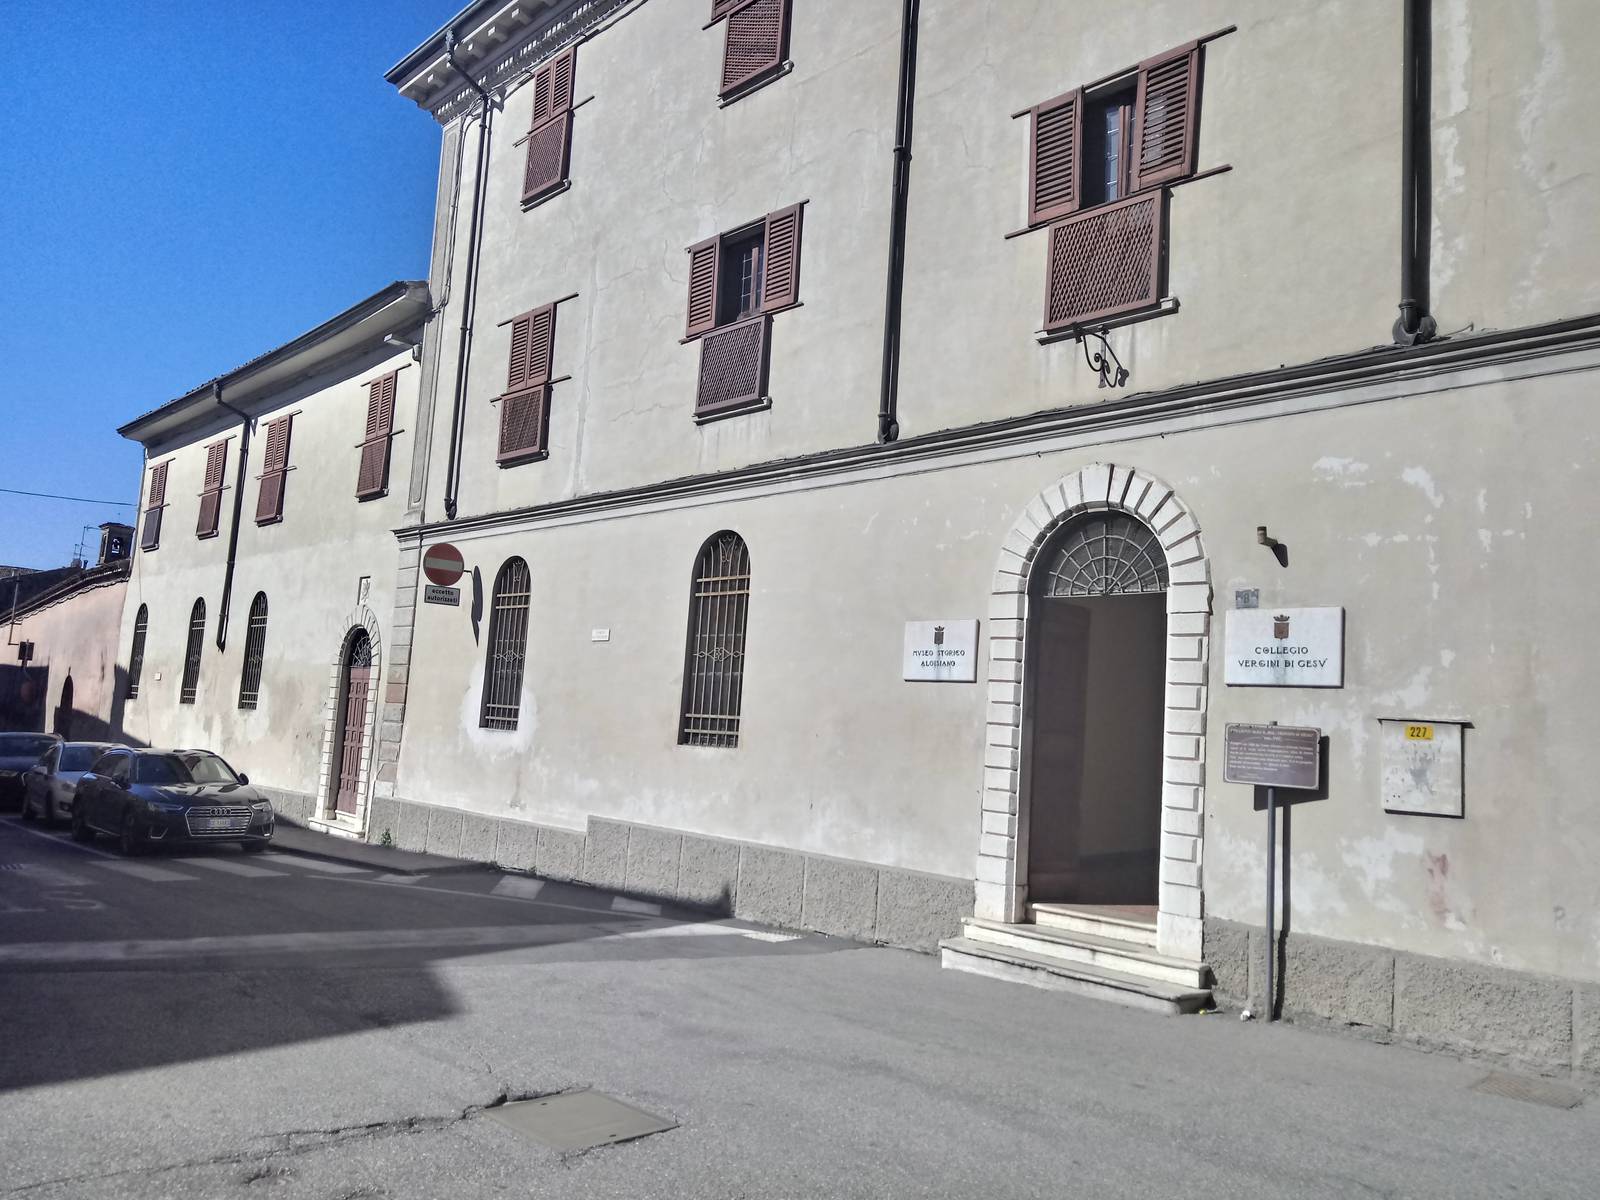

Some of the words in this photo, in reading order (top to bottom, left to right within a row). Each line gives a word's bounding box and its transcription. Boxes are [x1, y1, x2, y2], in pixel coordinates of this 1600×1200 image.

[1254, 646, 1309, 655] COLLEGIO
[1238, 659, 1280, 668] VERGINI
[1284, 659, 1294, 668] DI
[1410, 726, 1427, 738] 227
